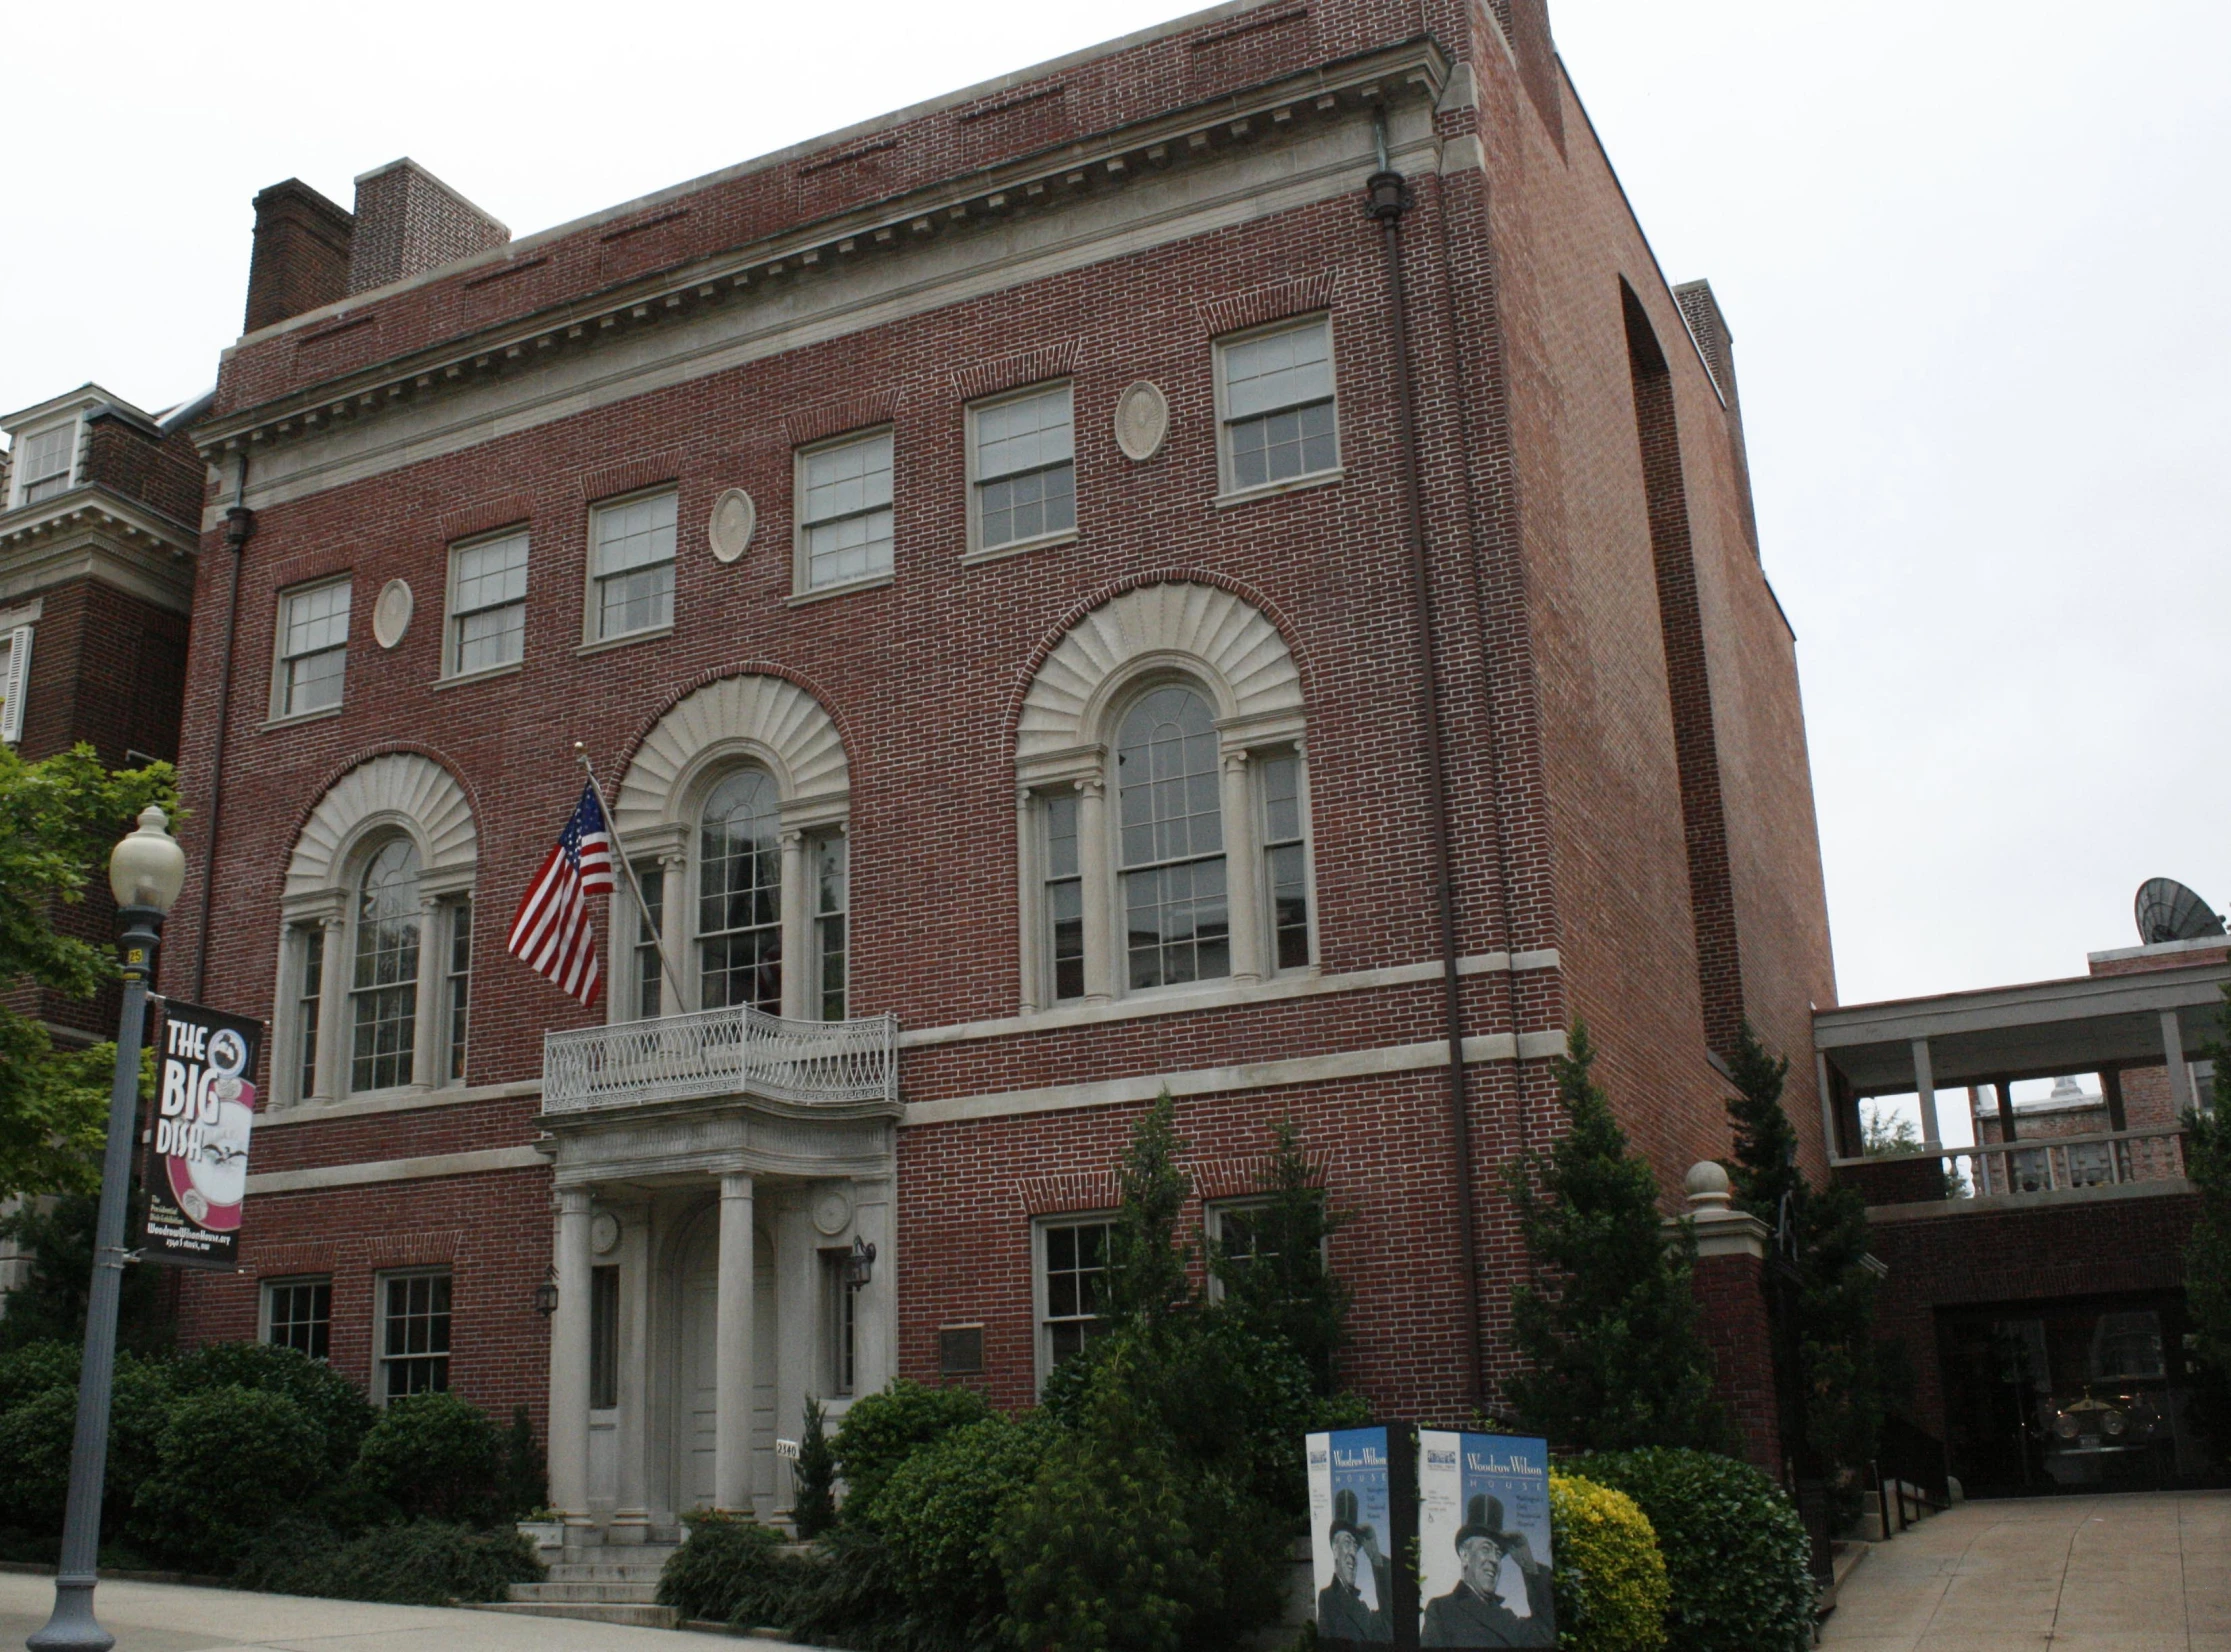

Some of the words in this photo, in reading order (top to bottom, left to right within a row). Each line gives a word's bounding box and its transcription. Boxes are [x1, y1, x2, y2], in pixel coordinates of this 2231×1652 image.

[130, 950, 141, 962] 25
[167, 1019, 208, 1060] THE
[161, 1058, 219, 1124] BIG
[156, 1118, 204, 1162] DISH
[778, 1444, 796, 1456] 2340
[1333, 1449, 1363, 1467] Woodrow
[1362, 1447, 1387, 1466] Wilson
[1467, 1452, 1510, 1473] Woodrow
[1510, 1455, 1543, 1475] Wilson
[1335, 1473, 1387, 1484] HOUSE
[1470, 1480, 1542, 1491] HOUSE
